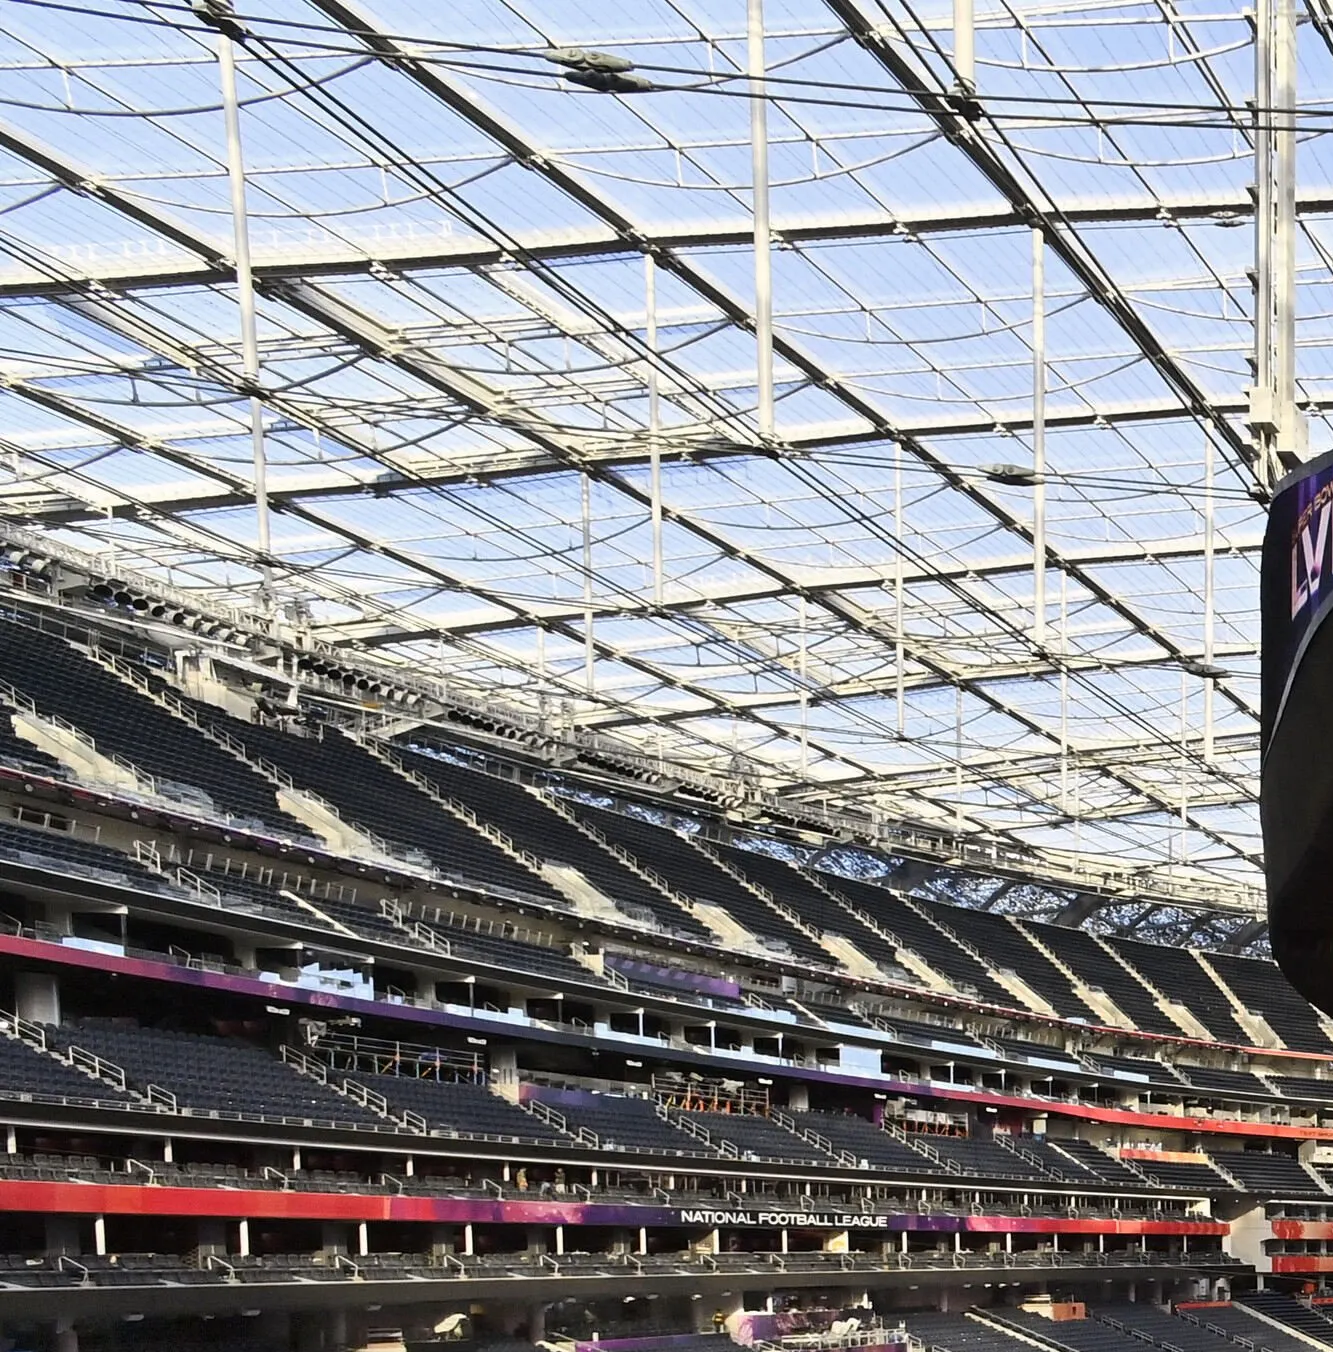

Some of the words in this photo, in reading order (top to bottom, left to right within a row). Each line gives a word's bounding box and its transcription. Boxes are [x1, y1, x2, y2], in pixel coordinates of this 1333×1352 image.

[681, 1210, 756, 1224] NATIONAL
[758, 1213, 833, 1226] FOOTBALL
[834, 1216, 888, 1228] LEAGUE
